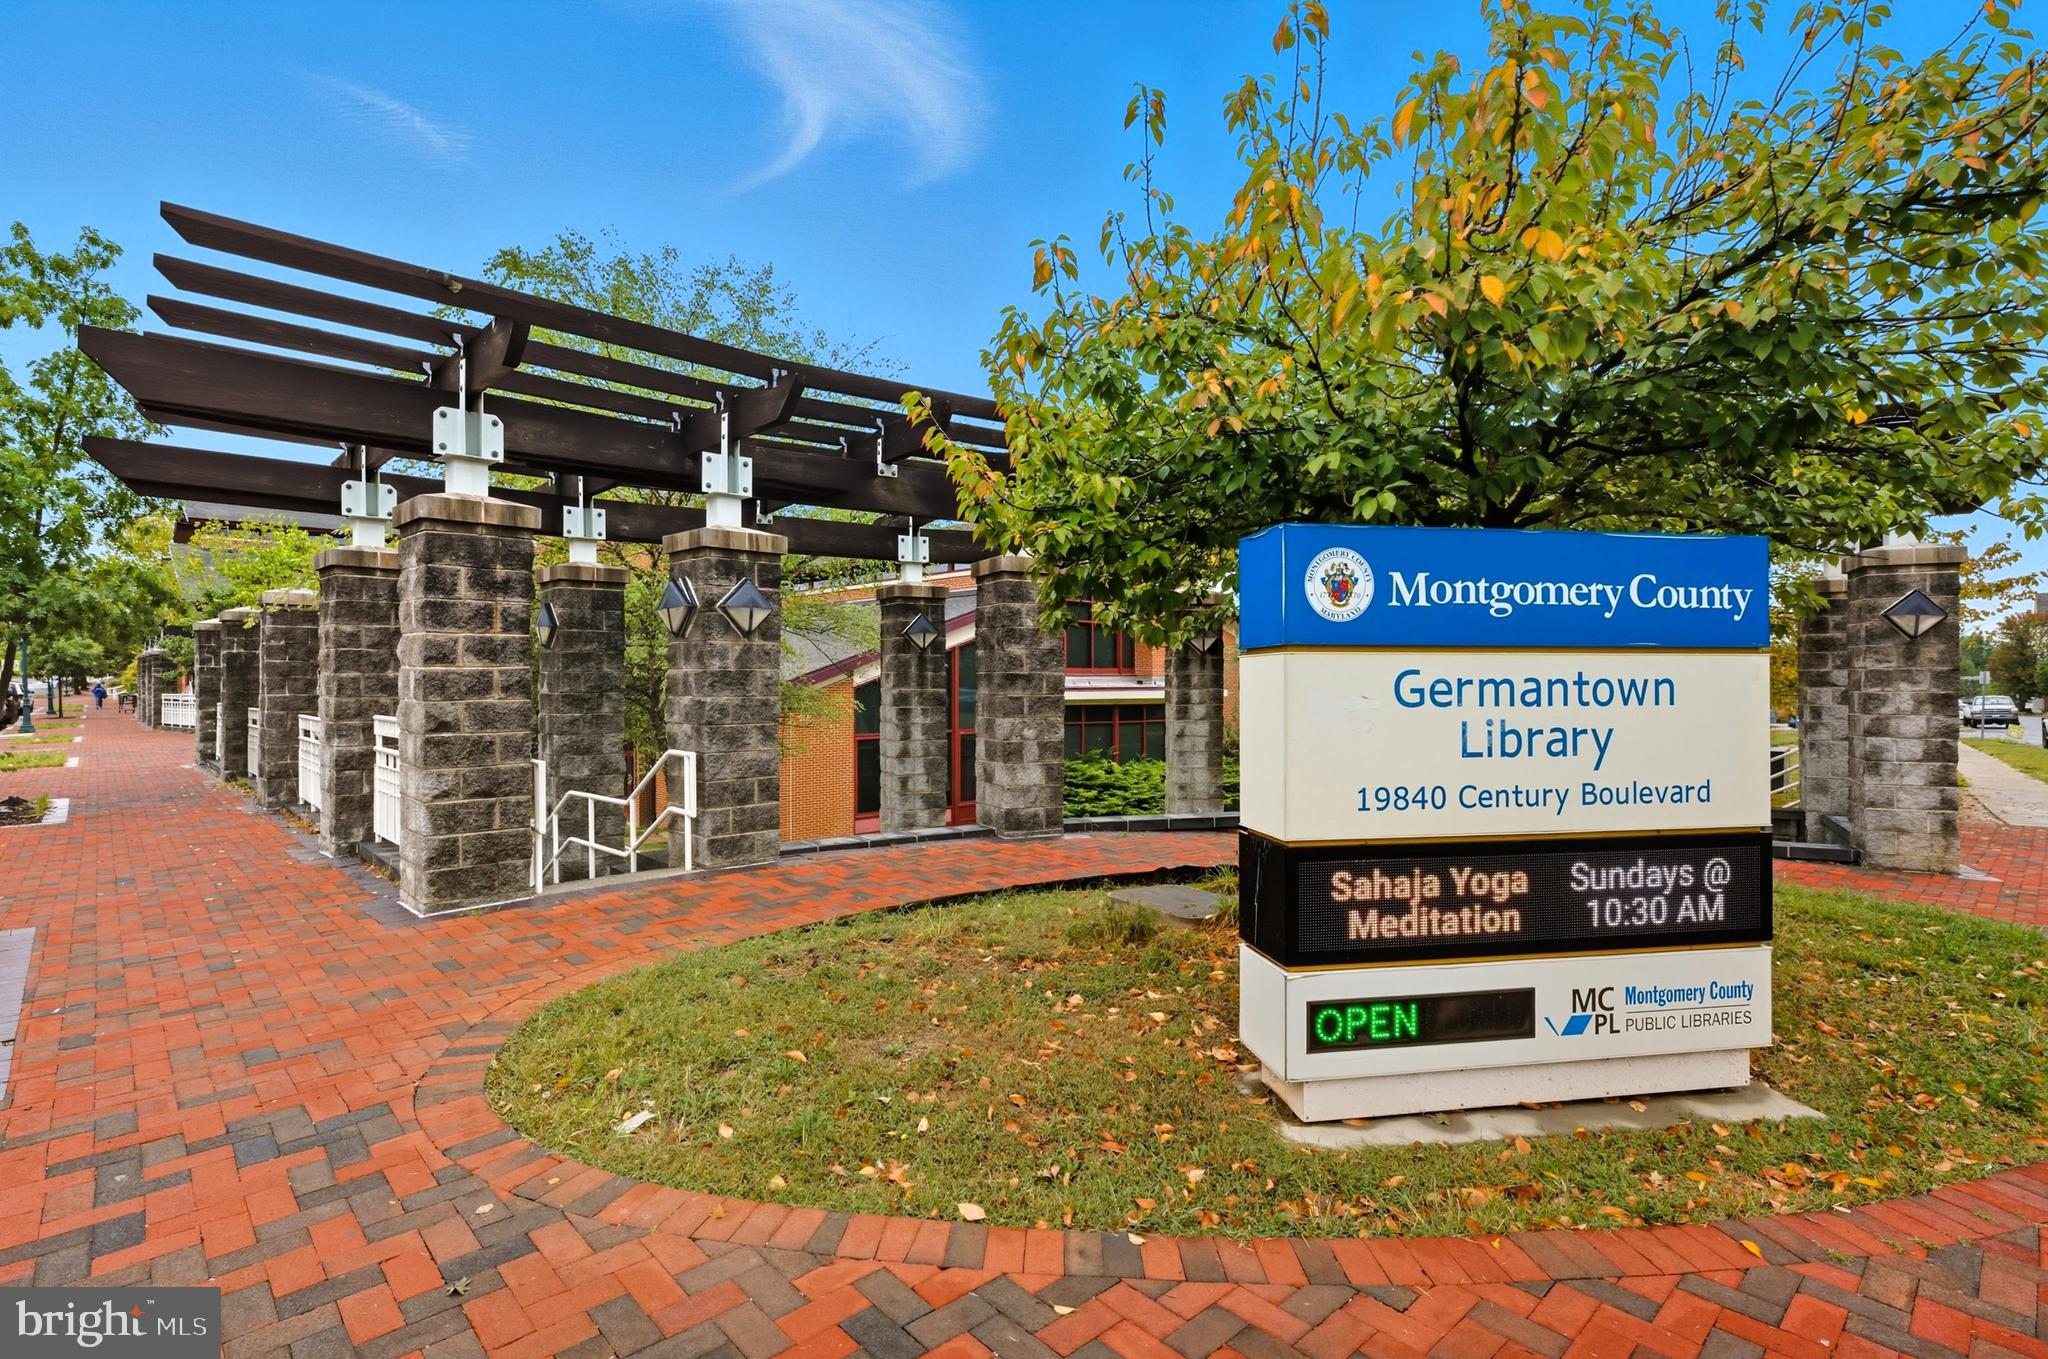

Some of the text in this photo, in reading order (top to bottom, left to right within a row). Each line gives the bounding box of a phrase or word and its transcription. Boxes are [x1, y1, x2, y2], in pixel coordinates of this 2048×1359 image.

[1307, 550, 1372, 583] MONTGOMERY COUNTY
[1320, 606, 1361, 620] MARYLAND
[1387, 571, 1753, 621] Montgomery County
[1393, 668, 1676, 709] Germantown
[1461, 718, 1614, 770] Library
[1357, 778, 1711, 815] 19840 Century Boulevard
[1330, 866, 1529, 907] Sahaja Yoga
[1570, 857, 1730, 899] Sundays @
[1348, 902, 1521, 940] Meditation
[1588, 893, 1725, 928] 10:30 AM
[1571, 986, 1615, 1014] MC
[1625, 980, 1754, 1008] Montgomery County
[1315, 1003, 1419, 1043] OPEN
[1594, 1014, 1620, 1036] PL
[1625, 1010, 1752, 1032] PUBLIC LIBRARIES
